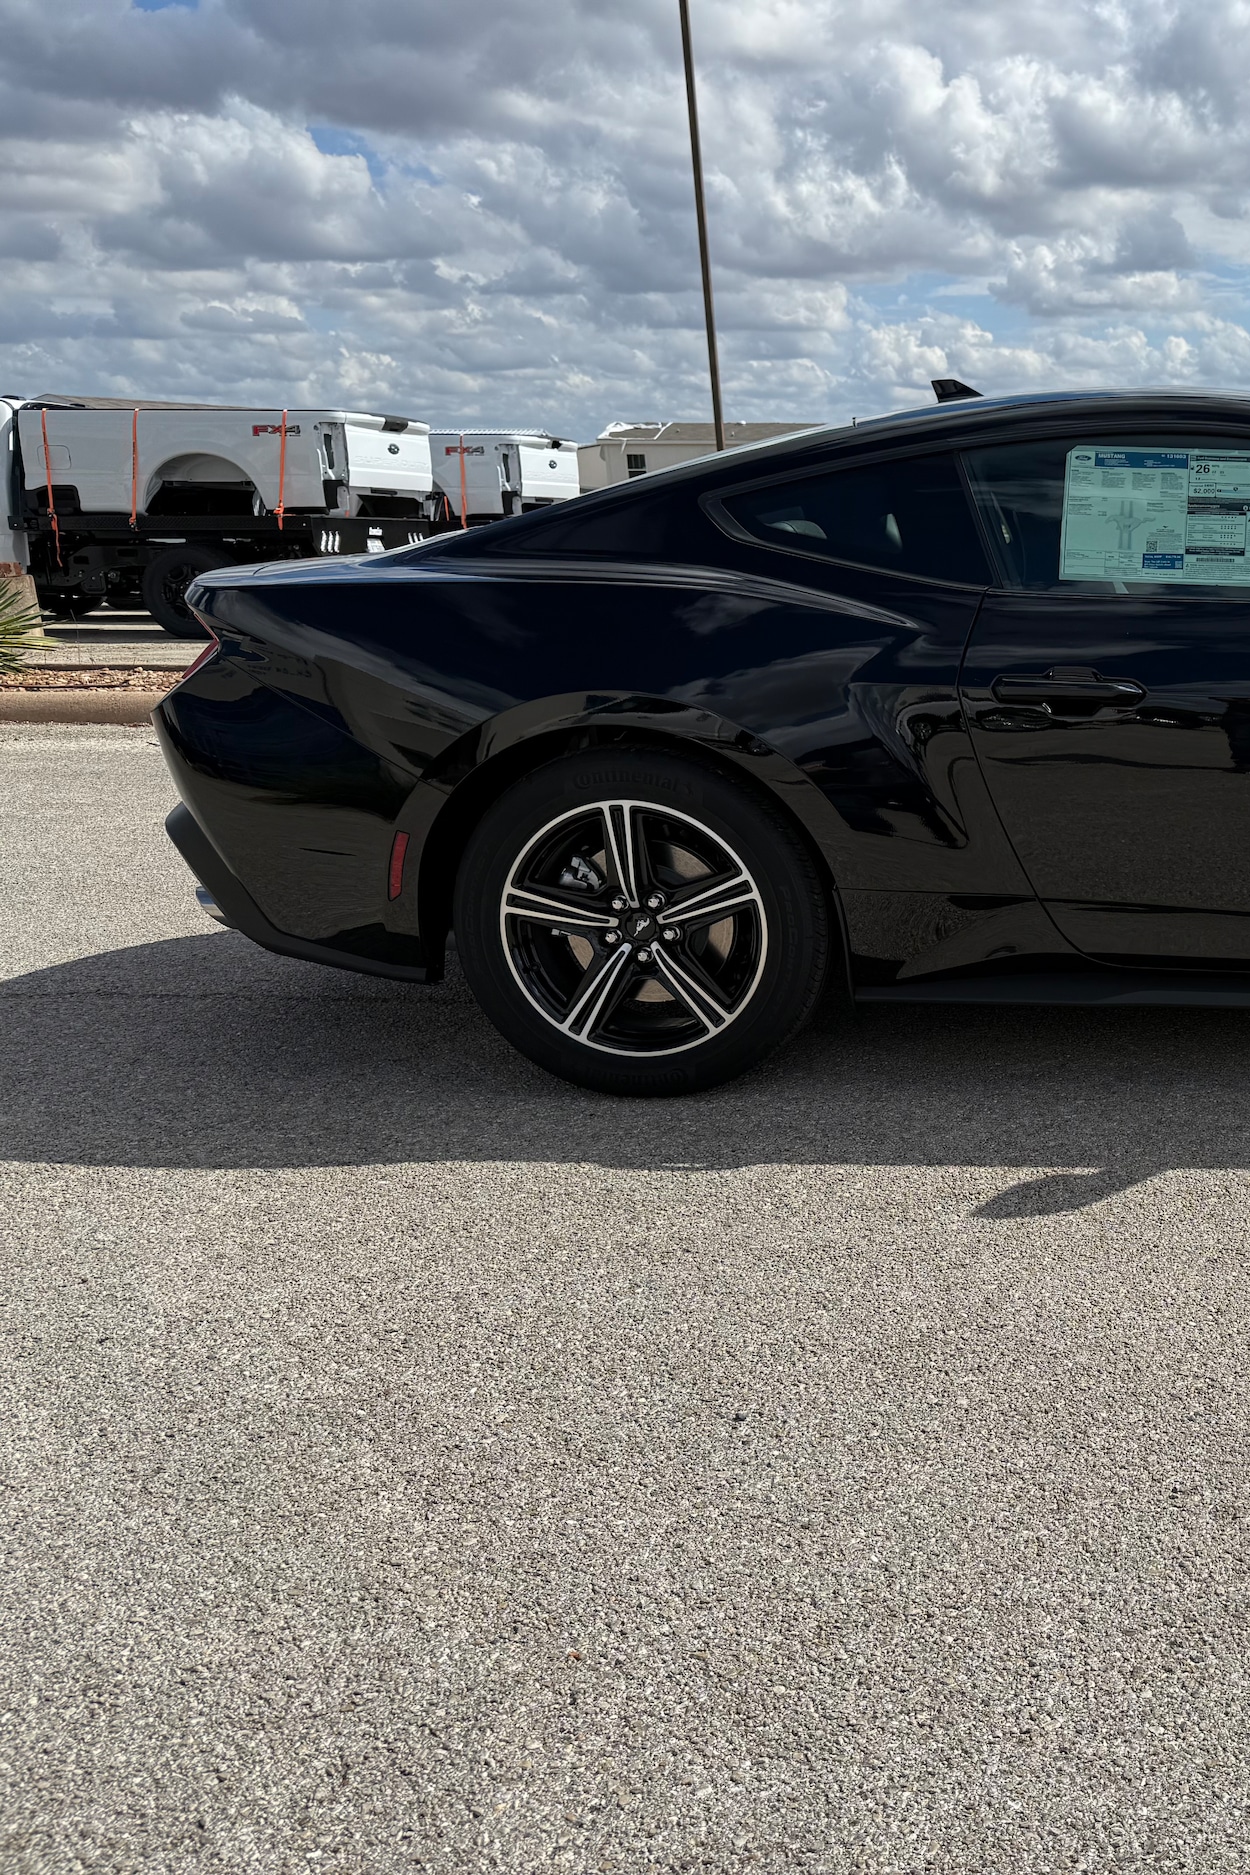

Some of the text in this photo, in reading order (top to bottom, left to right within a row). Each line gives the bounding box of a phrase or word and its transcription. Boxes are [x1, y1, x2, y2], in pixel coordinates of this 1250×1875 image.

[252, 424, 301, 436] FX4
[444, 446, 485, 456] FX4
[1195, 464, 1210, 474] 26
[573, 768, 680, 793] Continental
